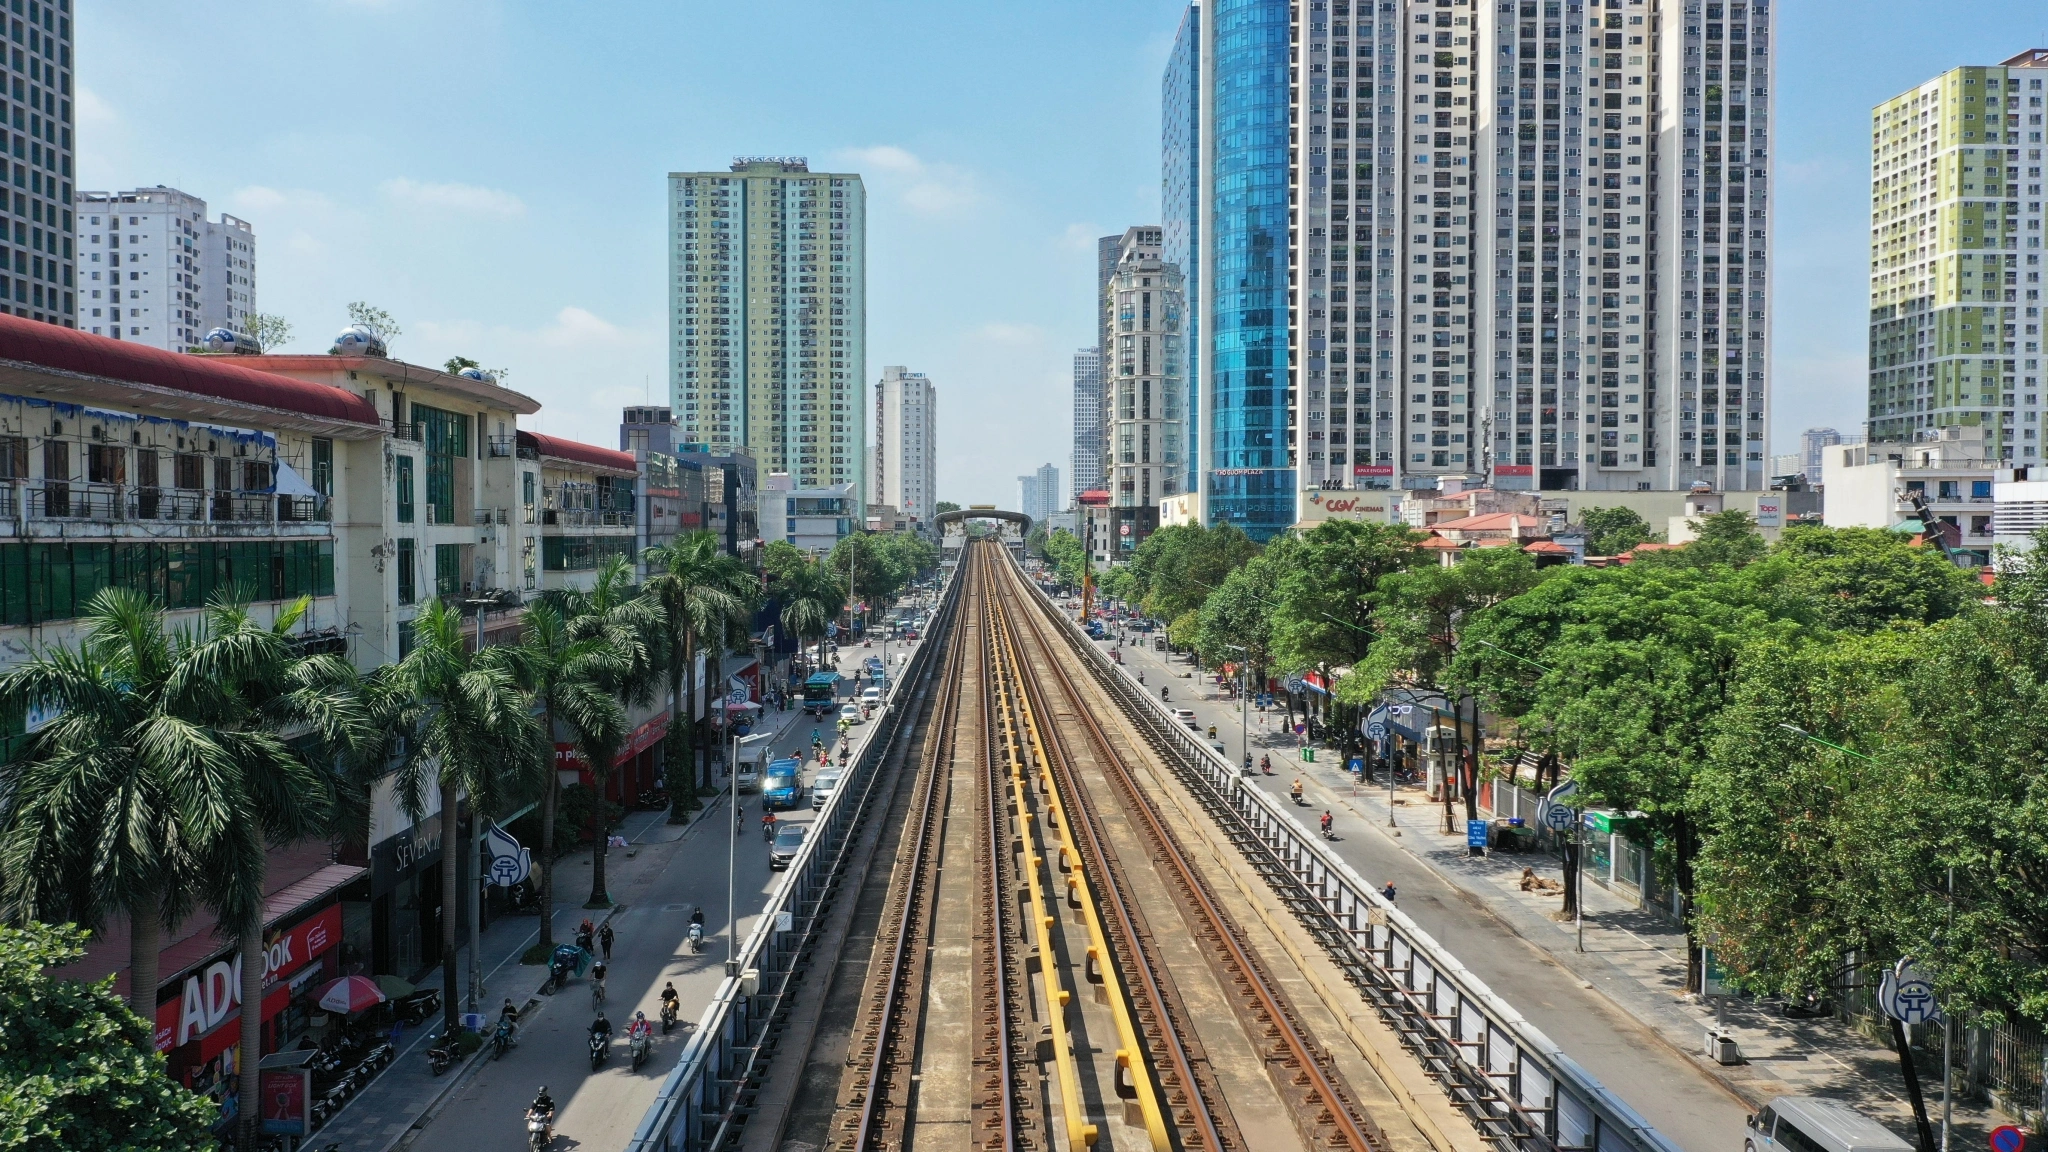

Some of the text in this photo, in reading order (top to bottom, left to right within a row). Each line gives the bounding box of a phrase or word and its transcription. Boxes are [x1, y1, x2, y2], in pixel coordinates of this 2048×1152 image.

[1247, 504, 1295, 512] POSEDON
[1326, 499, 1357, 512] CGV
[1759, 504, 1778, 514] Tops
